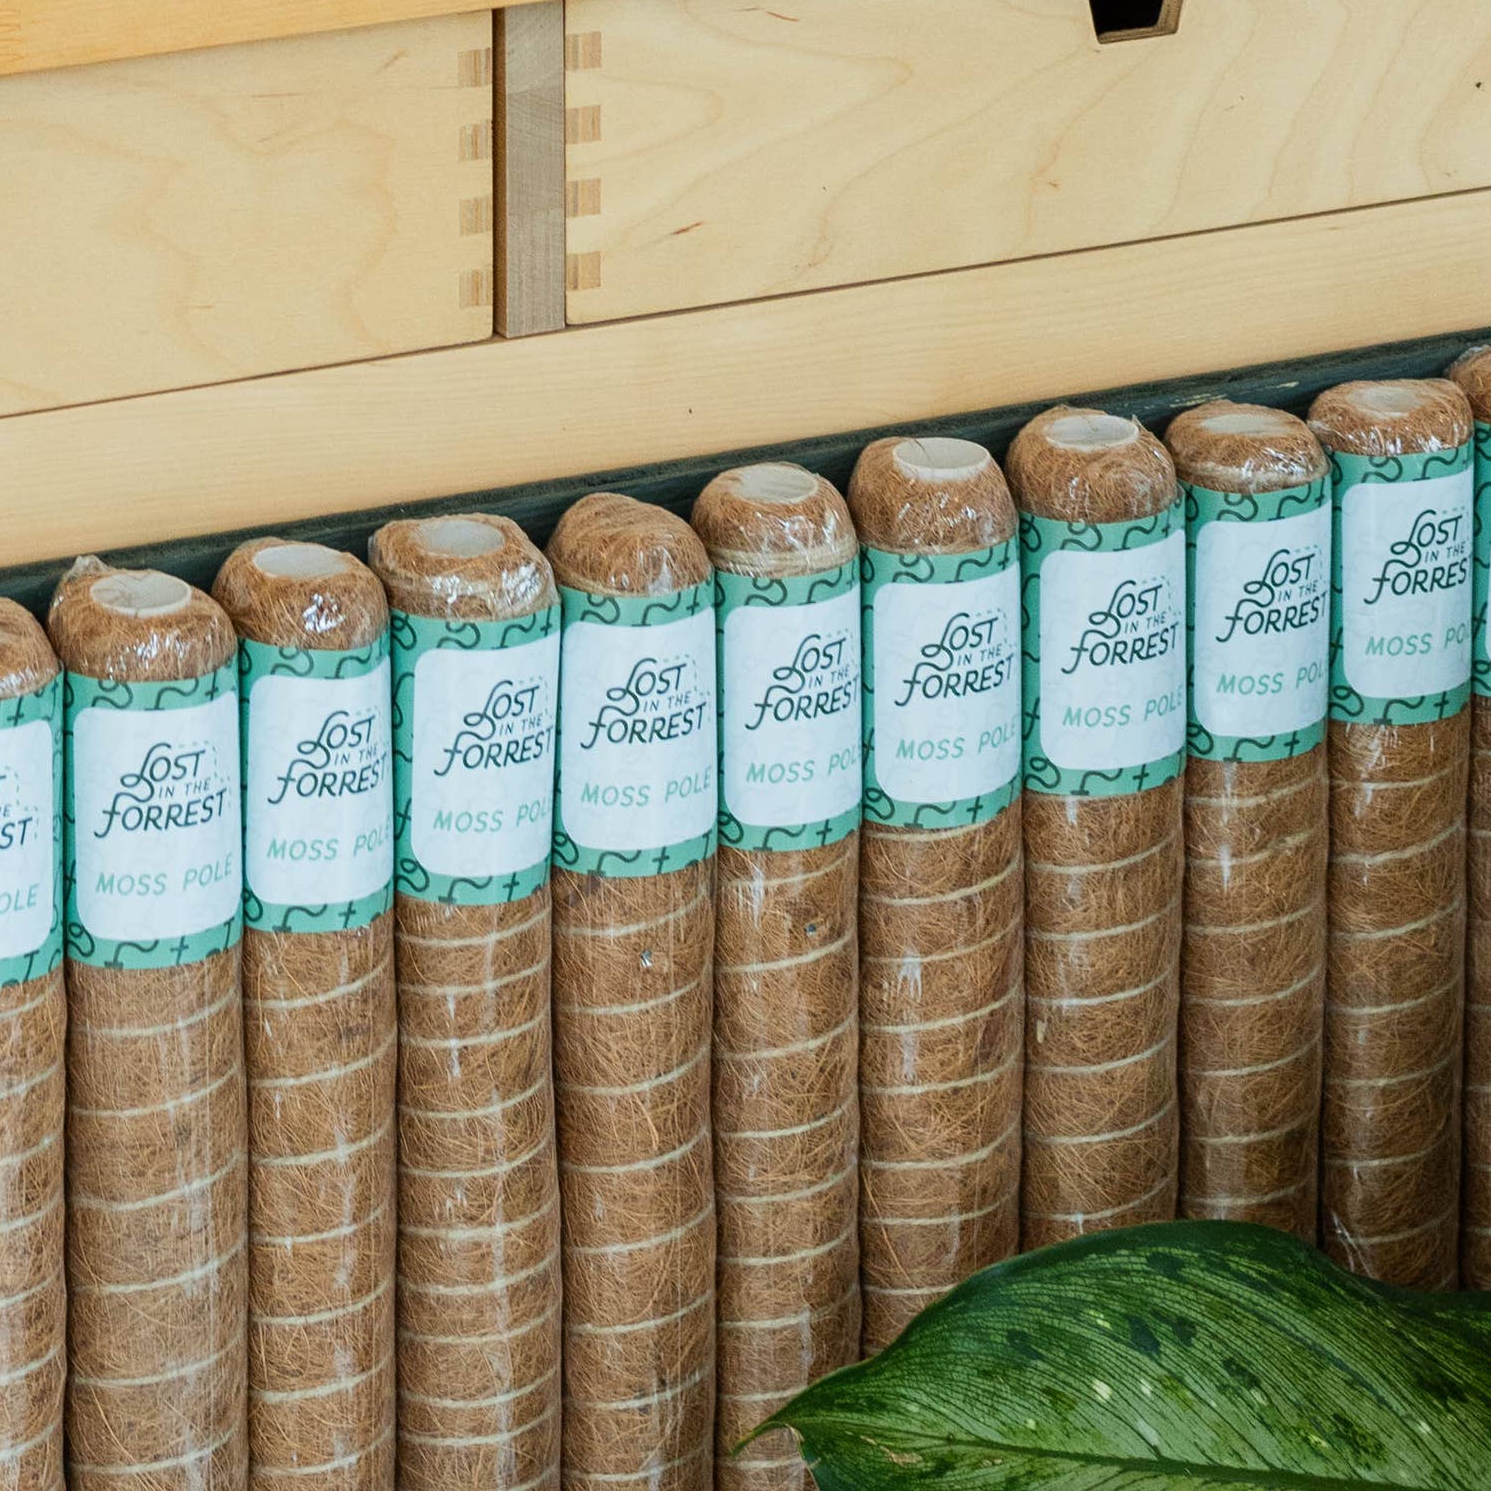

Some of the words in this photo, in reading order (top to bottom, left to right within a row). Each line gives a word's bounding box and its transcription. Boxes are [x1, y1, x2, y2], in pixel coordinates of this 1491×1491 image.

[1390, 509, 1463, 567] LOST
[1424, 548, 1440, 563] IN
[1446, 540, 1466, 559] THE
[1244, 549, 1315, 606] LOST
[1278, 587, 1292, 601] IN
[1299, 580, 1318, 597] THE
[1089, 580, 1162, 637] LOST
[1124, 619, 1140, 633] IN
[1146, 611, 1167, 629] THE
[921, 612, 999, 669] LOST
[1365, 633, 1432, 656] MOSS
[773, 633, 846, 691] LOST
[957, 652, 973, 666] IN
[981, 646, 1001, 663] THE
[606, 658, 687, 714] LOST
[808, 672, 823, 687] IN
[830, 666, 850, 683] THE
[1216, 672, 1284, 695] MOSS
[464, 680, 539, 738] LOST
[643, 697, 660, 712] IN
[668, 691, 691, 709] THE
[499, 721, 515, 736] IN
[521, 715, 541, 732] THE
[1063, 704, 1132, 727] MOSS
[297, 711, 375, 767] LOST
[895, 737, 965, 761] MOSS
[334, 751, 351, 765] IN
[360, 745, 378, 762] THE
[120, 743, 206, 799] LOST
[745, 759, 814, 785] MOSS
[159, 783, 176, 797] IN
[186, 779, 210, 793] THE
[580, 782, 650, 808] MOSS
[665, 765, 711, 802] POLE
[433, 810, 504, 834] MOSS
[266, 838, 339, 862] MOSS
[95, 872, 167, 896] MOSS
[183, 854, 233, 892] POLE
